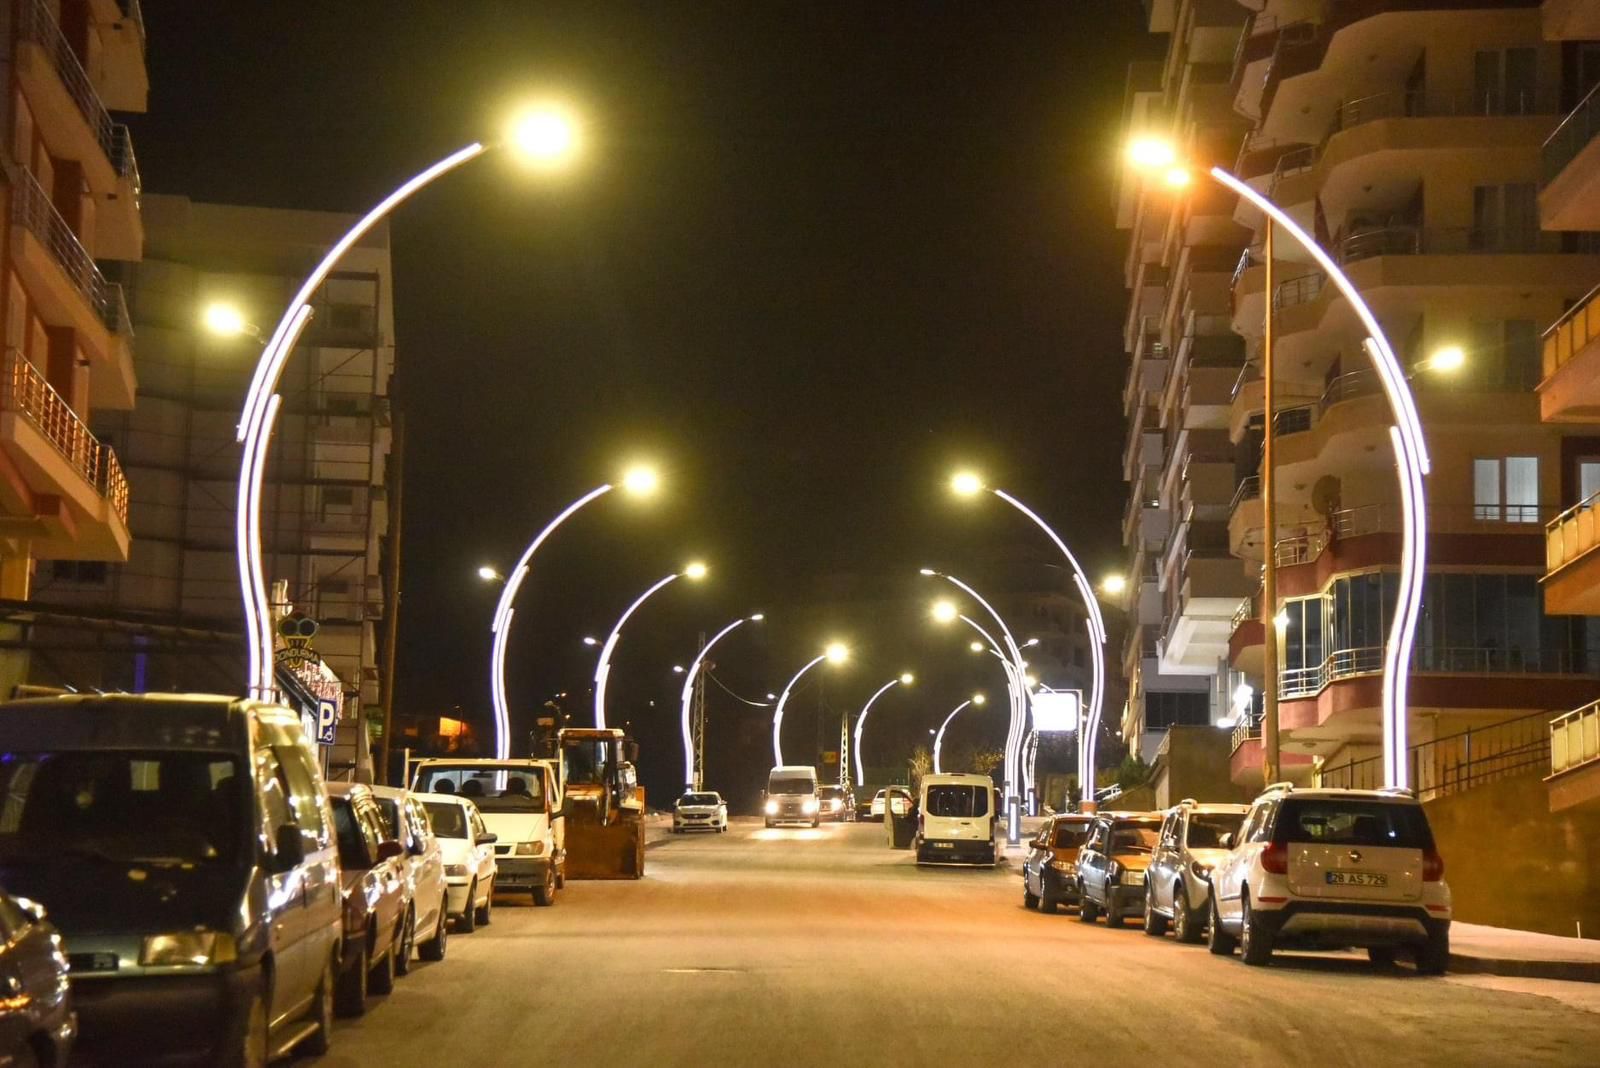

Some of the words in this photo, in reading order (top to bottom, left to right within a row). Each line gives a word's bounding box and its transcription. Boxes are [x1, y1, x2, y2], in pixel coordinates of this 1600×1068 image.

[318, 702, 334, 739] P
[1332, 874, 1345, 884] 28
[1348, 874, 1364, 884] AS
